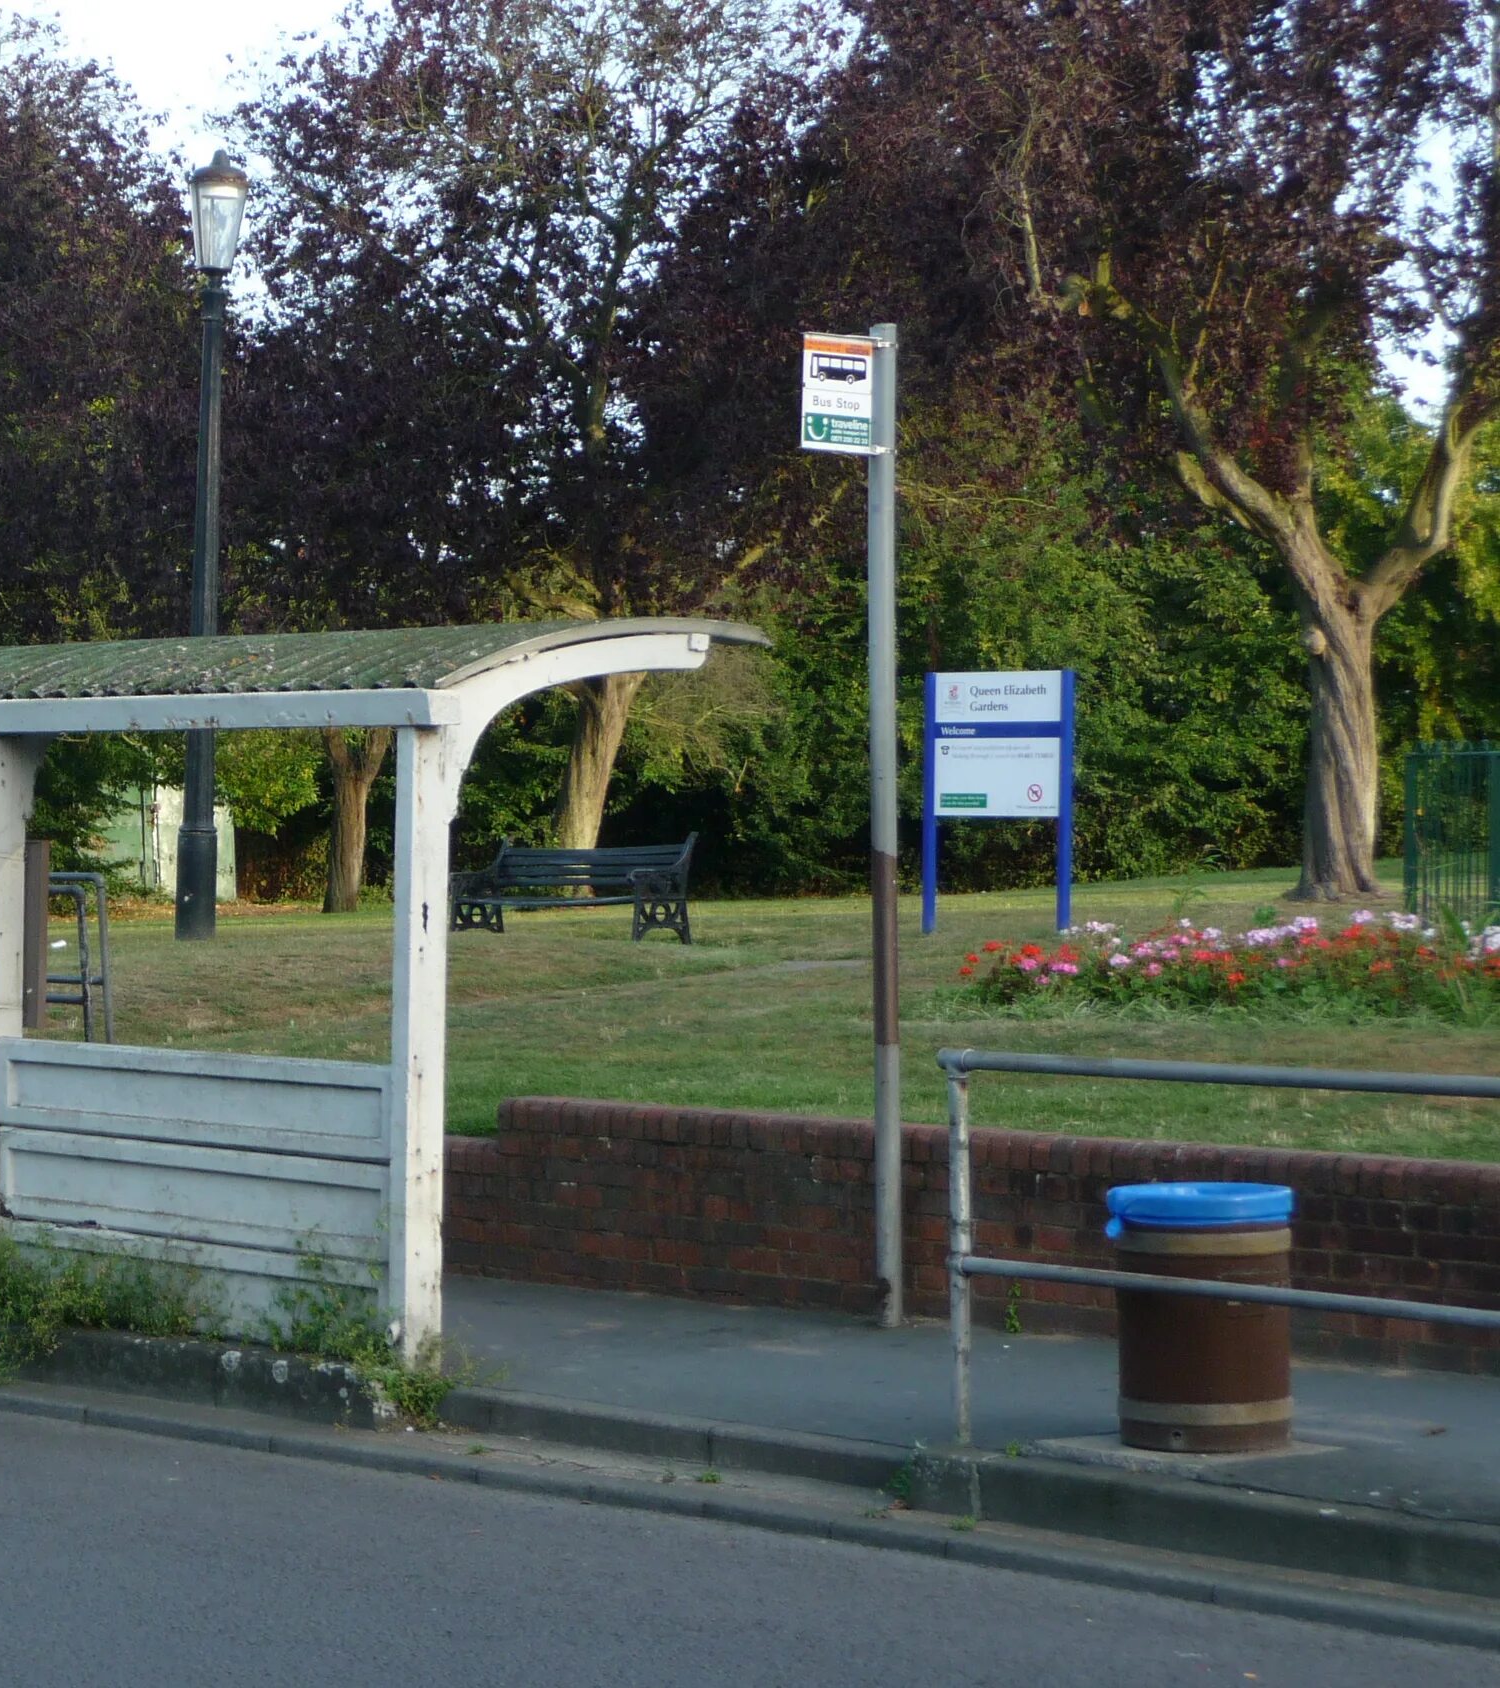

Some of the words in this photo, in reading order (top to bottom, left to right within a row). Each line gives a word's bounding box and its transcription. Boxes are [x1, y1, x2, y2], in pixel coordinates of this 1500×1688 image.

[813, 395, 832, 407] Bus
[836, 398, 860, 411] Stop
[831, 419, 868, 430] traveline
[969, 685, 1001, 697] Queen
[1004, 684, 1046, 695] Elizabeth
[969, 701, 1008, 711] Gardens
[941, 727, 975, 735] Welcome
